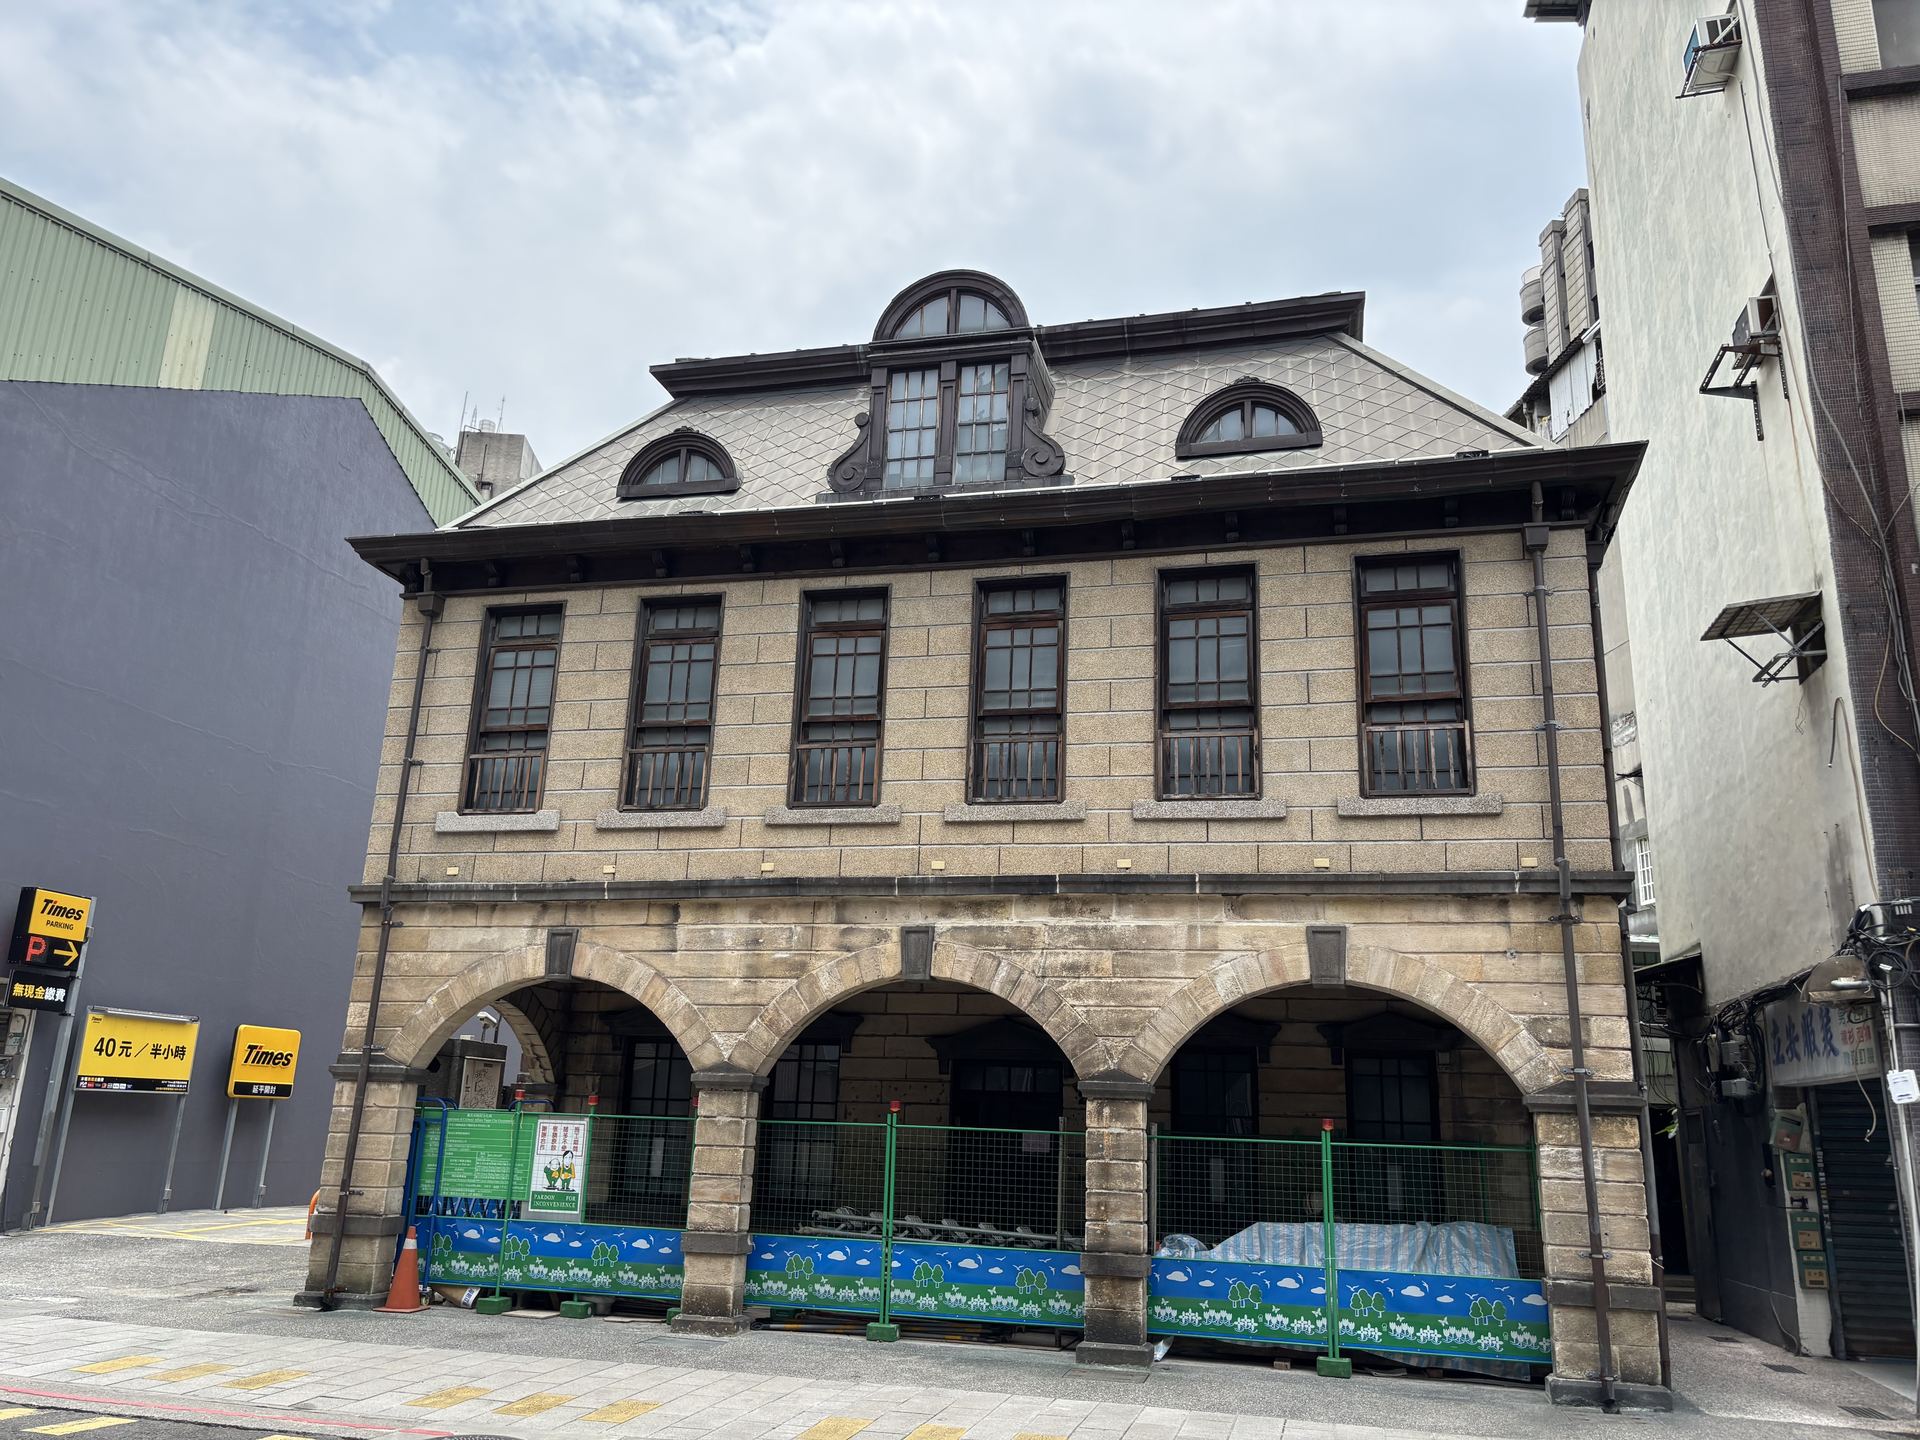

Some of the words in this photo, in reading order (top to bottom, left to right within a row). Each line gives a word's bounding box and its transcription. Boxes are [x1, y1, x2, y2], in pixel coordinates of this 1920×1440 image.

[40, 898, 84, 921] Times
[46, 920, 74, 931] PARKING
[25, 935, 47, 962] P
[12, 982, 66, 1002] 無現金繳費
[243, 1044, 293, 1067] Times
[533, 1200, 576, 1208] INCONVENIENCE
